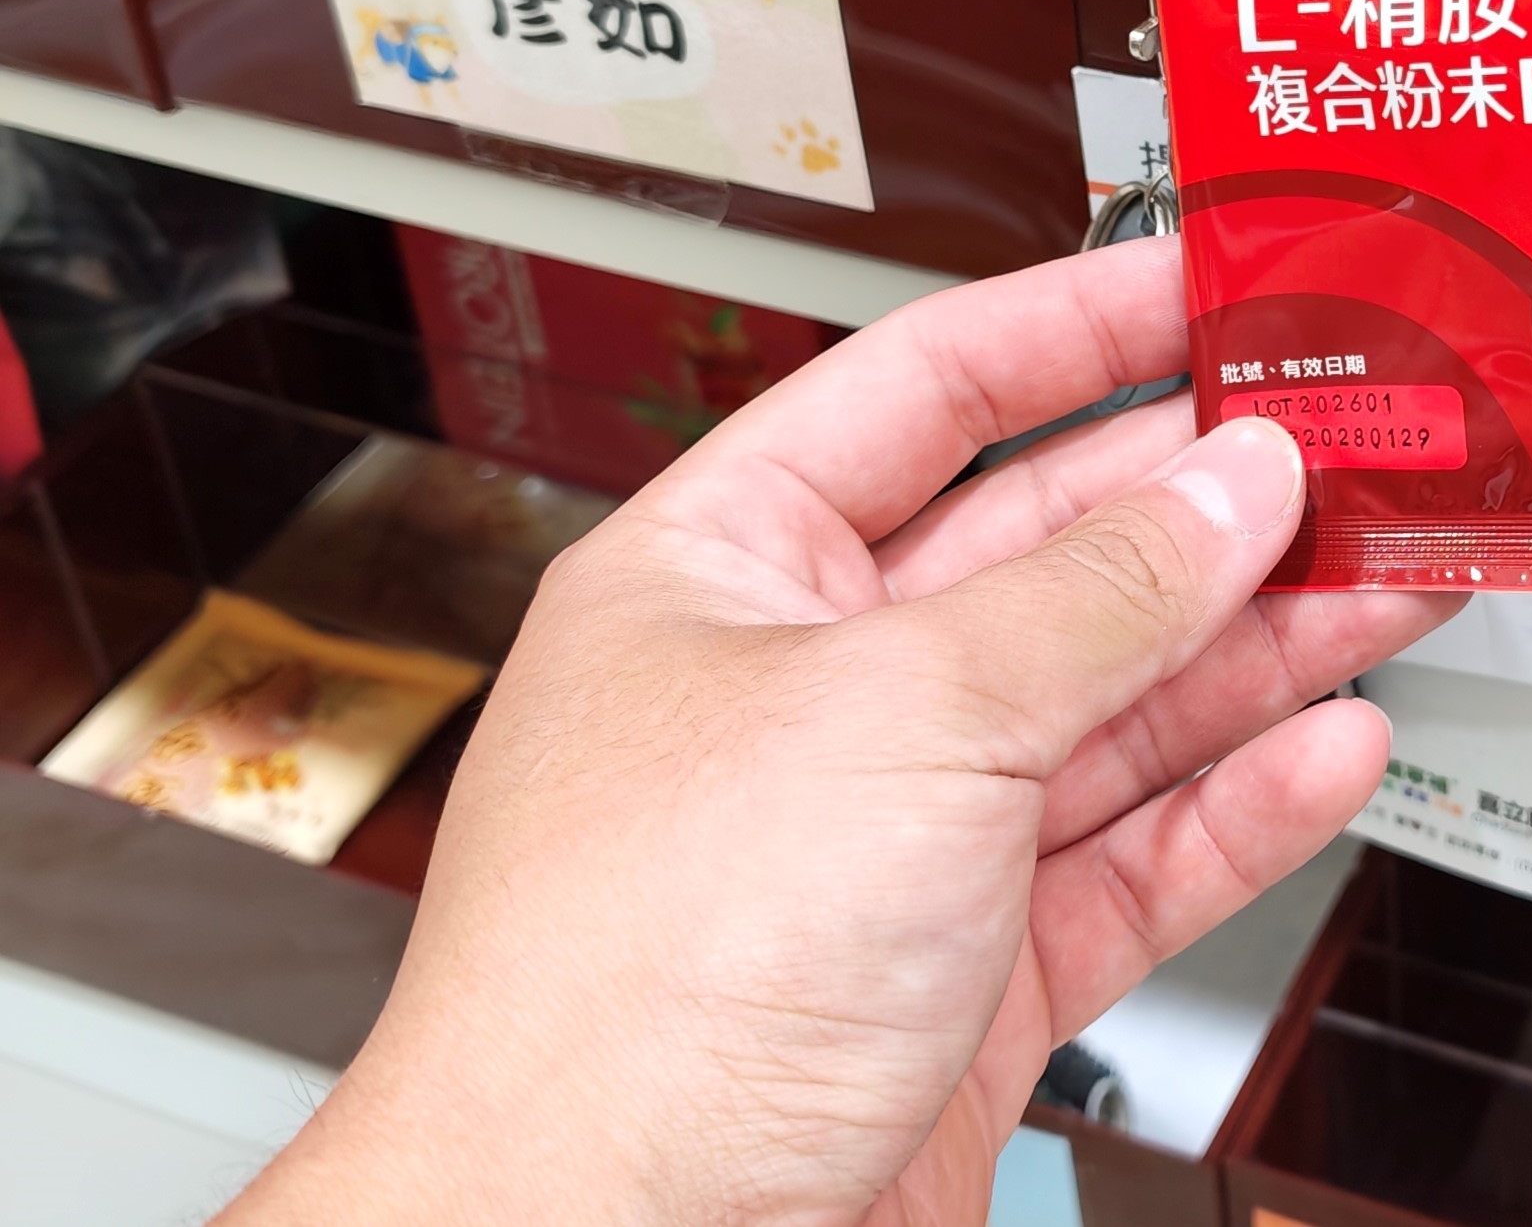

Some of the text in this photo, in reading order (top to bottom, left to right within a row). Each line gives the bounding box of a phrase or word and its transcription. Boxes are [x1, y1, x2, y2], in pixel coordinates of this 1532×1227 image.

[1219, 354, 1367, 385] 批號、有效日期
[1253, 392, 1393, 418] LOT 202601
